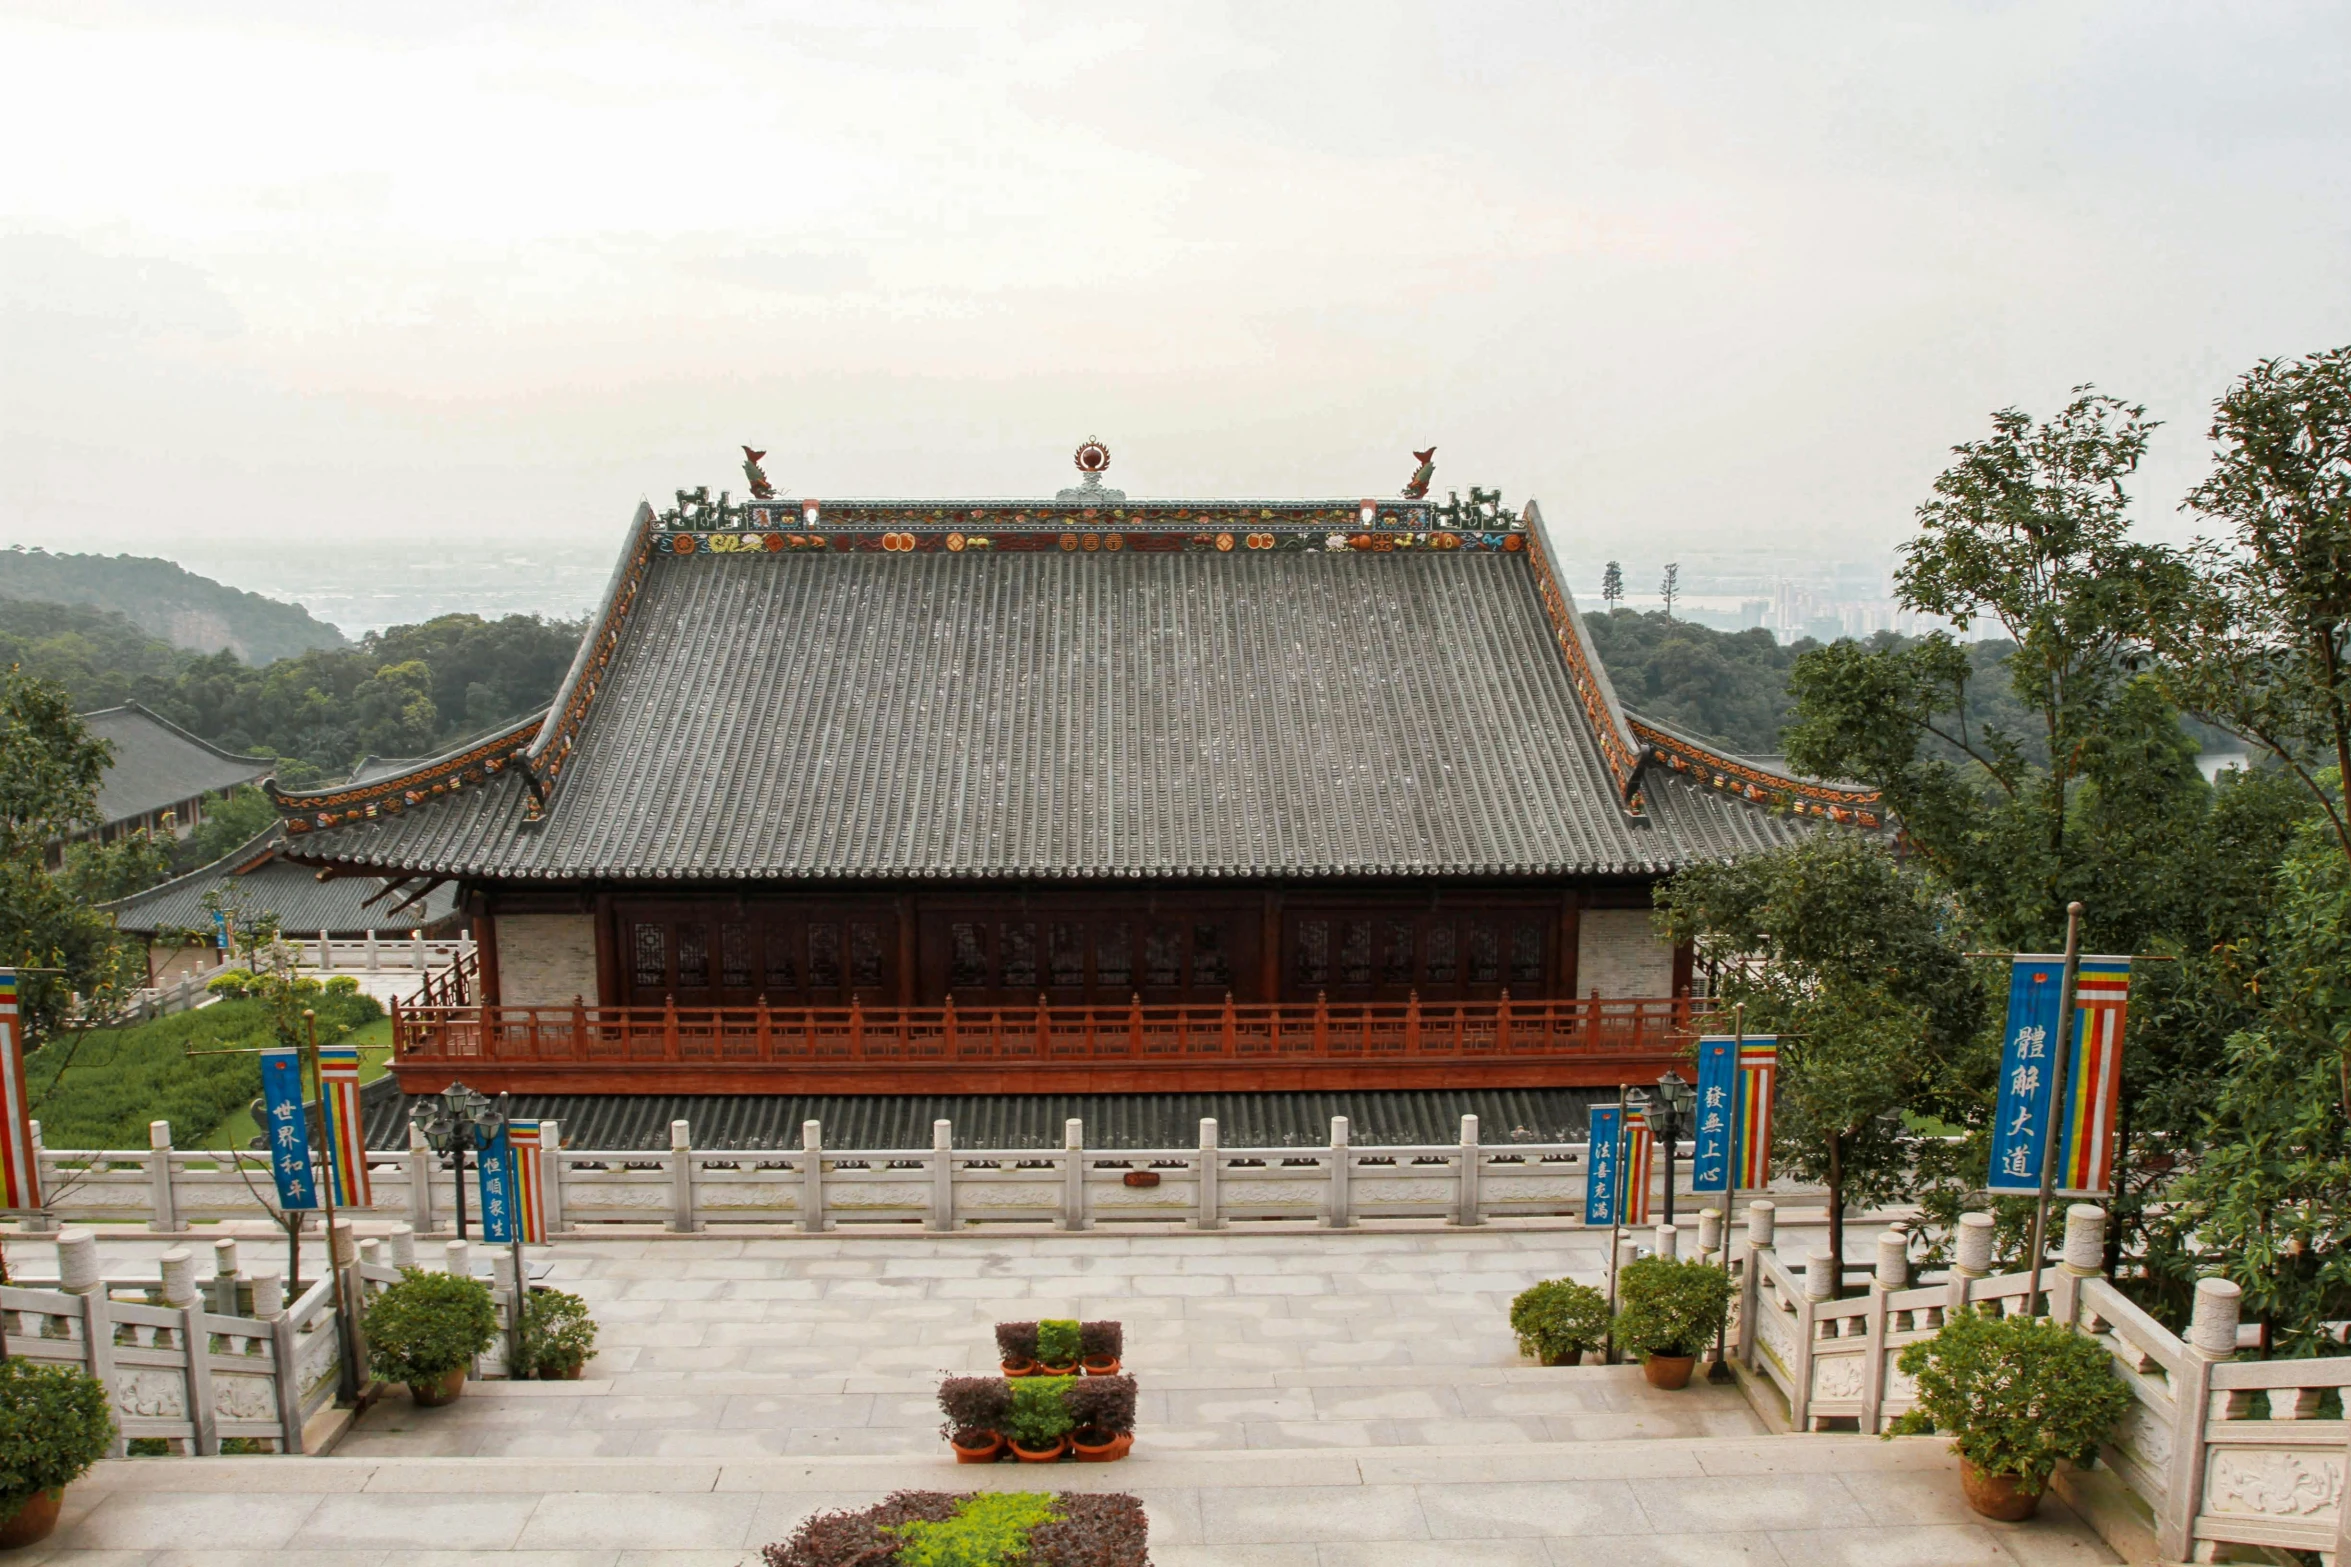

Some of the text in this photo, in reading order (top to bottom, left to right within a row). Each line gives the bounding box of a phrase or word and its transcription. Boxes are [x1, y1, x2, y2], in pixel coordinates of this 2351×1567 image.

[272, 1099, 307, 1202] 世界和平
[1699, 1085, 1727, 1182] 發無上心
[2002, 1025, 2046, 1178] 體解大道
